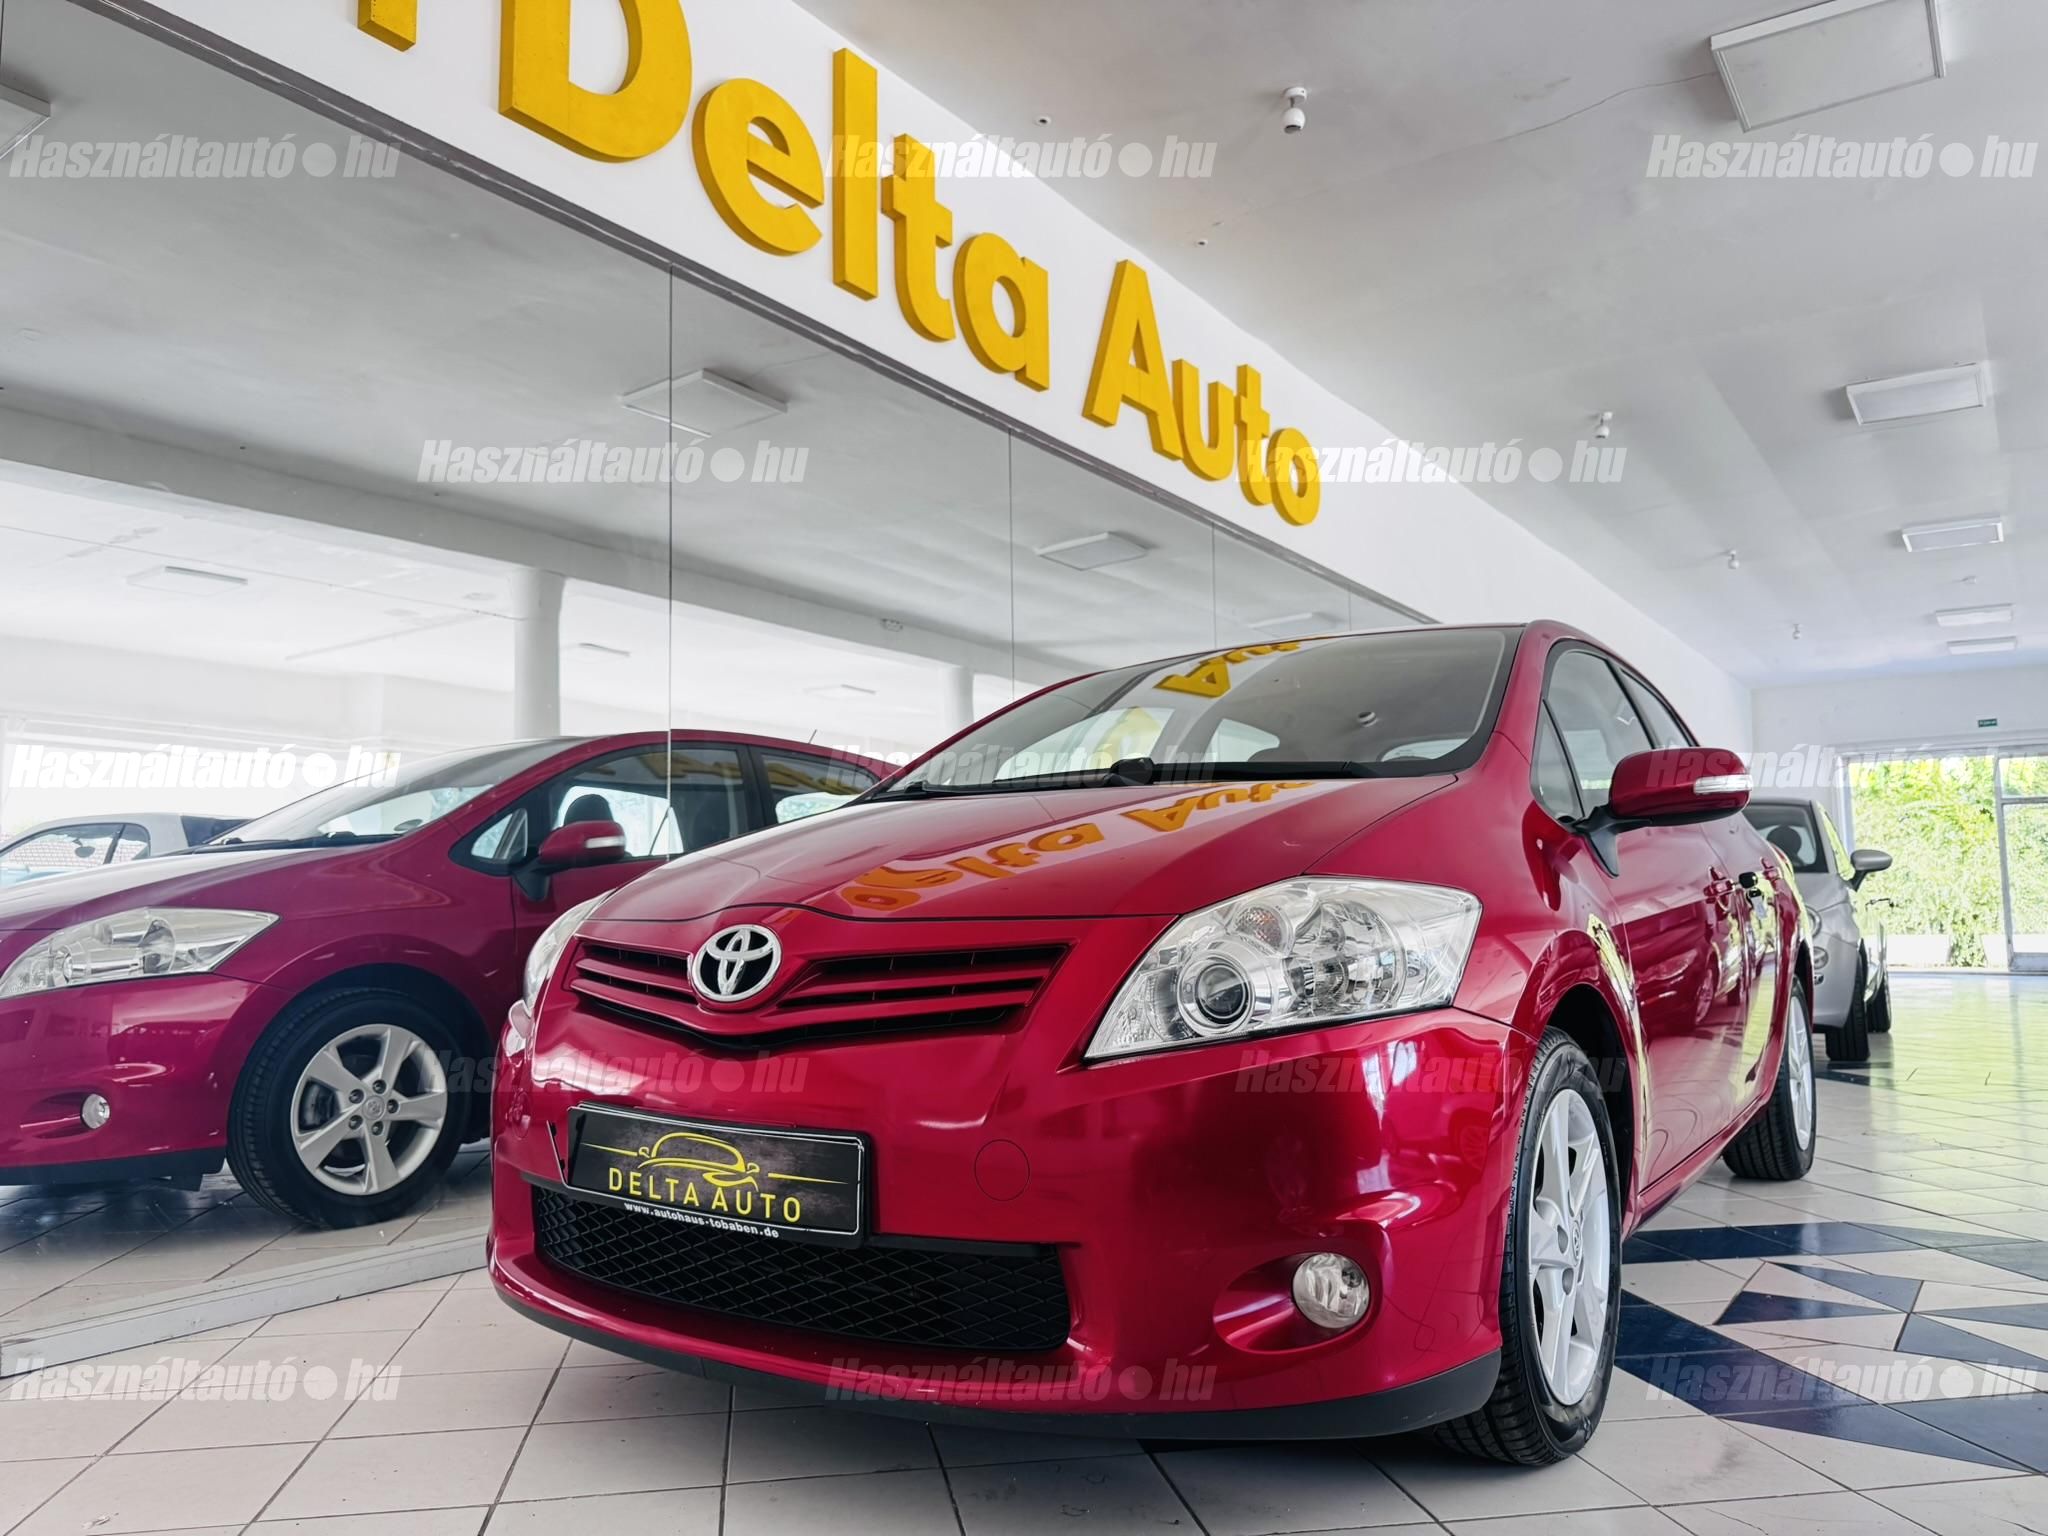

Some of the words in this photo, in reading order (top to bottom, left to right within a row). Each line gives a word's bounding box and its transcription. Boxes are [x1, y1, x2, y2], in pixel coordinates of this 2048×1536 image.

[500, 0, 1049, 392] Delta
[1081, 258, 1321, 526] Auto
[608, 1167, 700, 1208] DELTA
[711, 1187, 802, 1223] AUTO
[623, 1201, 780, 1239] www.autohaus-tobaben.de
